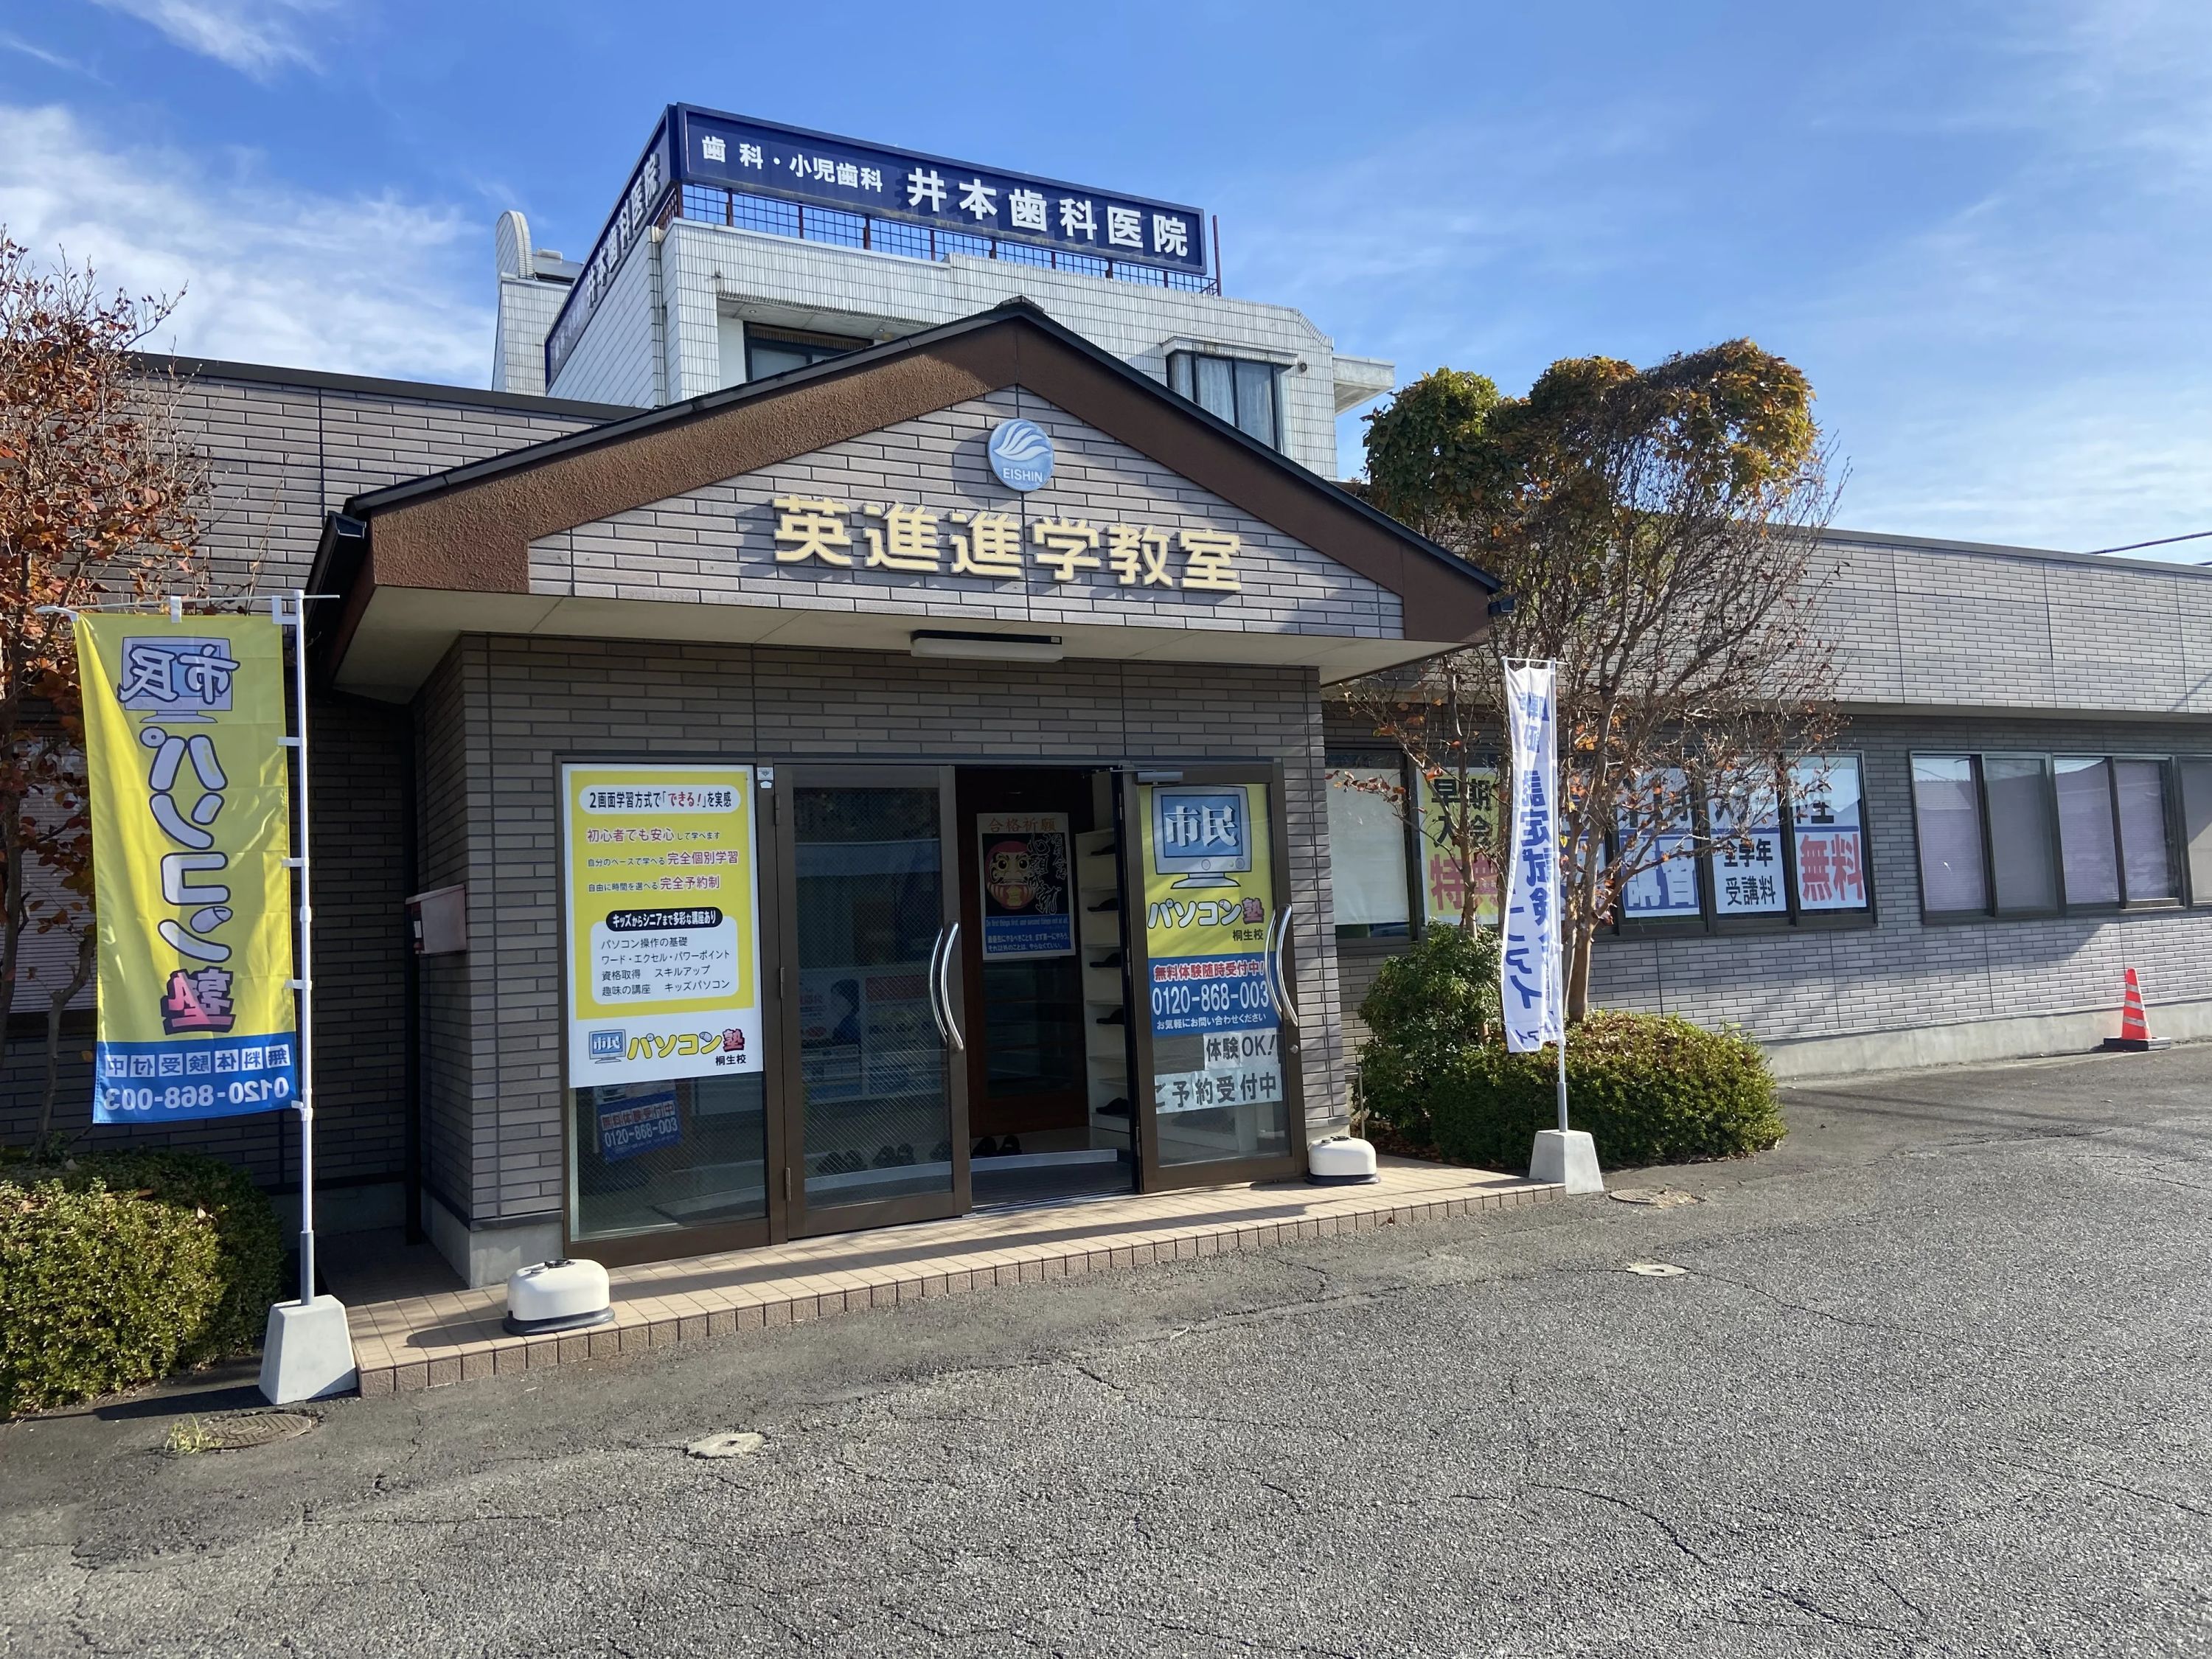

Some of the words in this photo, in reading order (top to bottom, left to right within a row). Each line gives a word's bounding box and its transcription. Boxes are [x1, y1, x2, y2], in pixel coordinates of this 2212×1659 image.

[906, 167, 1189, 257] 井本歯科医院
[1001, 467, 1044, 484] EISHIN
[772, 493, 1242, 592] 英進進学教室
[1164, 805, 1239, 848] 市民
[1800, 833, 1864, 902] 無料
[1725, 875, 1776, 906] 受講料
[1147, 897, 1265, 930] パソコン塾
[601, 936, 688, 950] パソコン操作の基礎
[1233, 929, 1264, 942] 桐生校
[602, 969, 641, 981] 資格取得
[655, 965, 710, 978] スキルアップ
[602, 984, 651, 996] 趣味の講座
[664, 980, 730, 992] キッズパソコン
[1152, 981, 1269, 1016] 0120-868-003
[1157, 1013, 1267, 1031] お気軽にお問い合わせください
[715, 1054, 747, 1066] 桐生校
[605, 1118, 678, 1147] 0120-868-003
